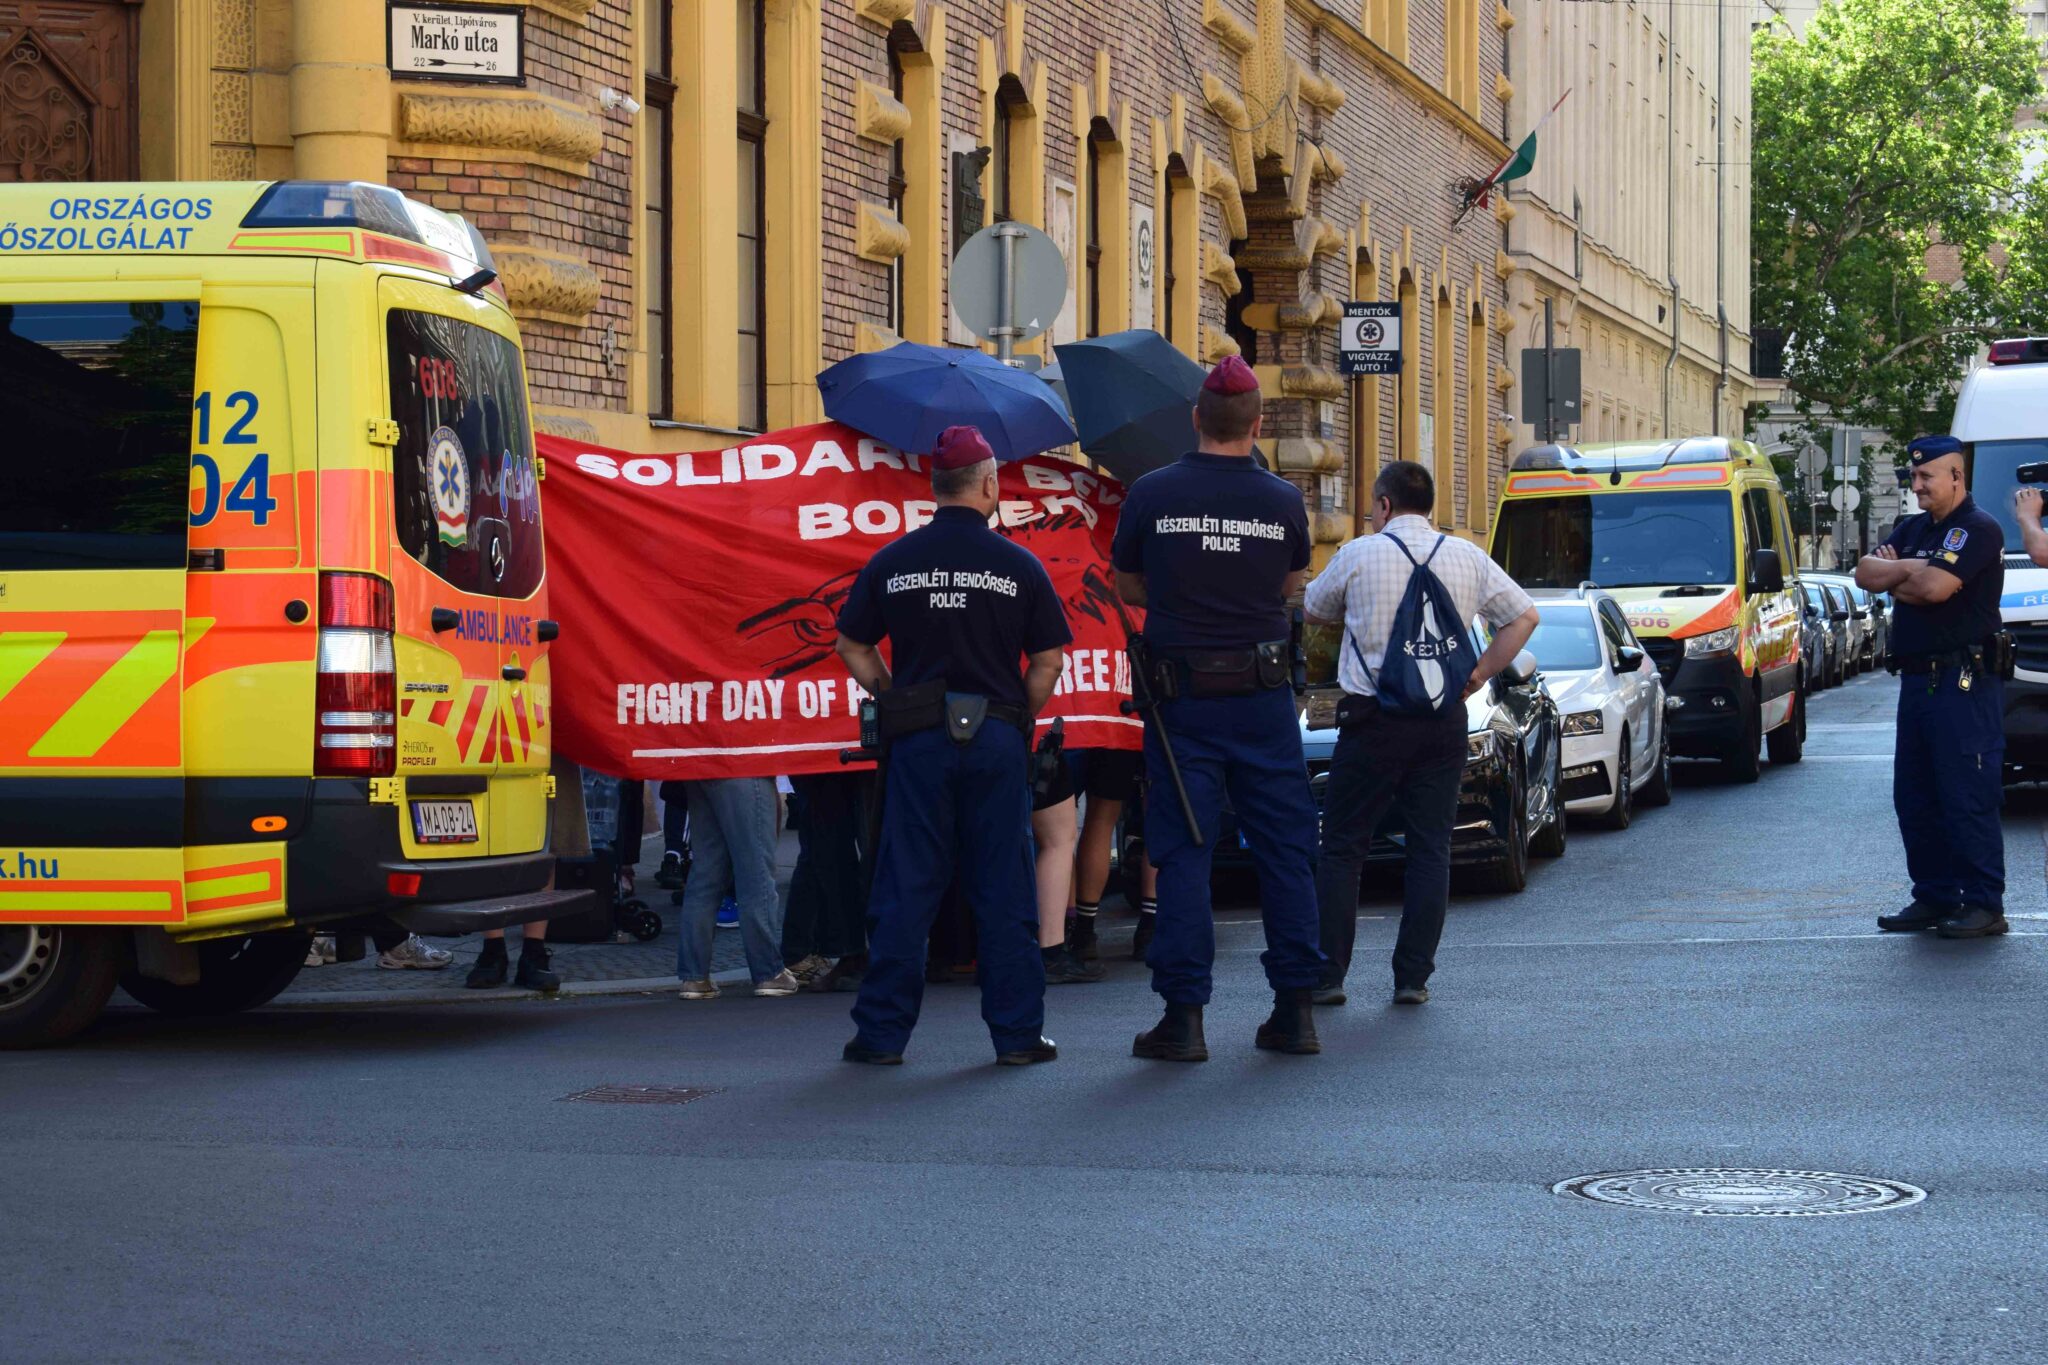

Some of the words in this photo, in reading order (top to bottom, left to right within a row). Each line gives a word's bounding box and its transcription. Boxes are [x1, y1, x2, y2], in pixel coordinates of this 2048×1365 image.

[412, 13, 420, 23] V.
[455, 15, 497, 28] Lipótváros
[411, 25, 459, 51] Markó
[465, 30, 498, 53] utca
[413, 57, 425, 67] 22
[486, 61, 497, 71] 26
[50, 193, 213, 220] ORSZÁGOS
[1348, 306, 1391, 316] MENTŐK
[1348, 352, 1393, 362] VIGYÁZZ,
[1353, 362, 1380, 372] AUTÓ
[419, 356, 457, 401] 608
[575, 438, 922, 486] SOLIDARI
[799, 495, 1098, 540] BORERS
[1156, 514, 1219, 534] KÉSZENLÉTI
[1222, 518, 1285, 541] RENDŐRSÉG
[1202, 535, 1241, 552] POLICE
[886, 568, 949, 594] KÉSZENLÉTI
[953, 570, 1018, 597] RENDŐRSÉG
[930, 592, 967, 608] POLICE
[456, 608, 532, 647] AMBULANCE
[617, 681, 713, 726] FIGHT
[722, 679, 785, 722] DAY
[798, 679, 836, 719] OF
[1054, 648, 1110, 697] REE
